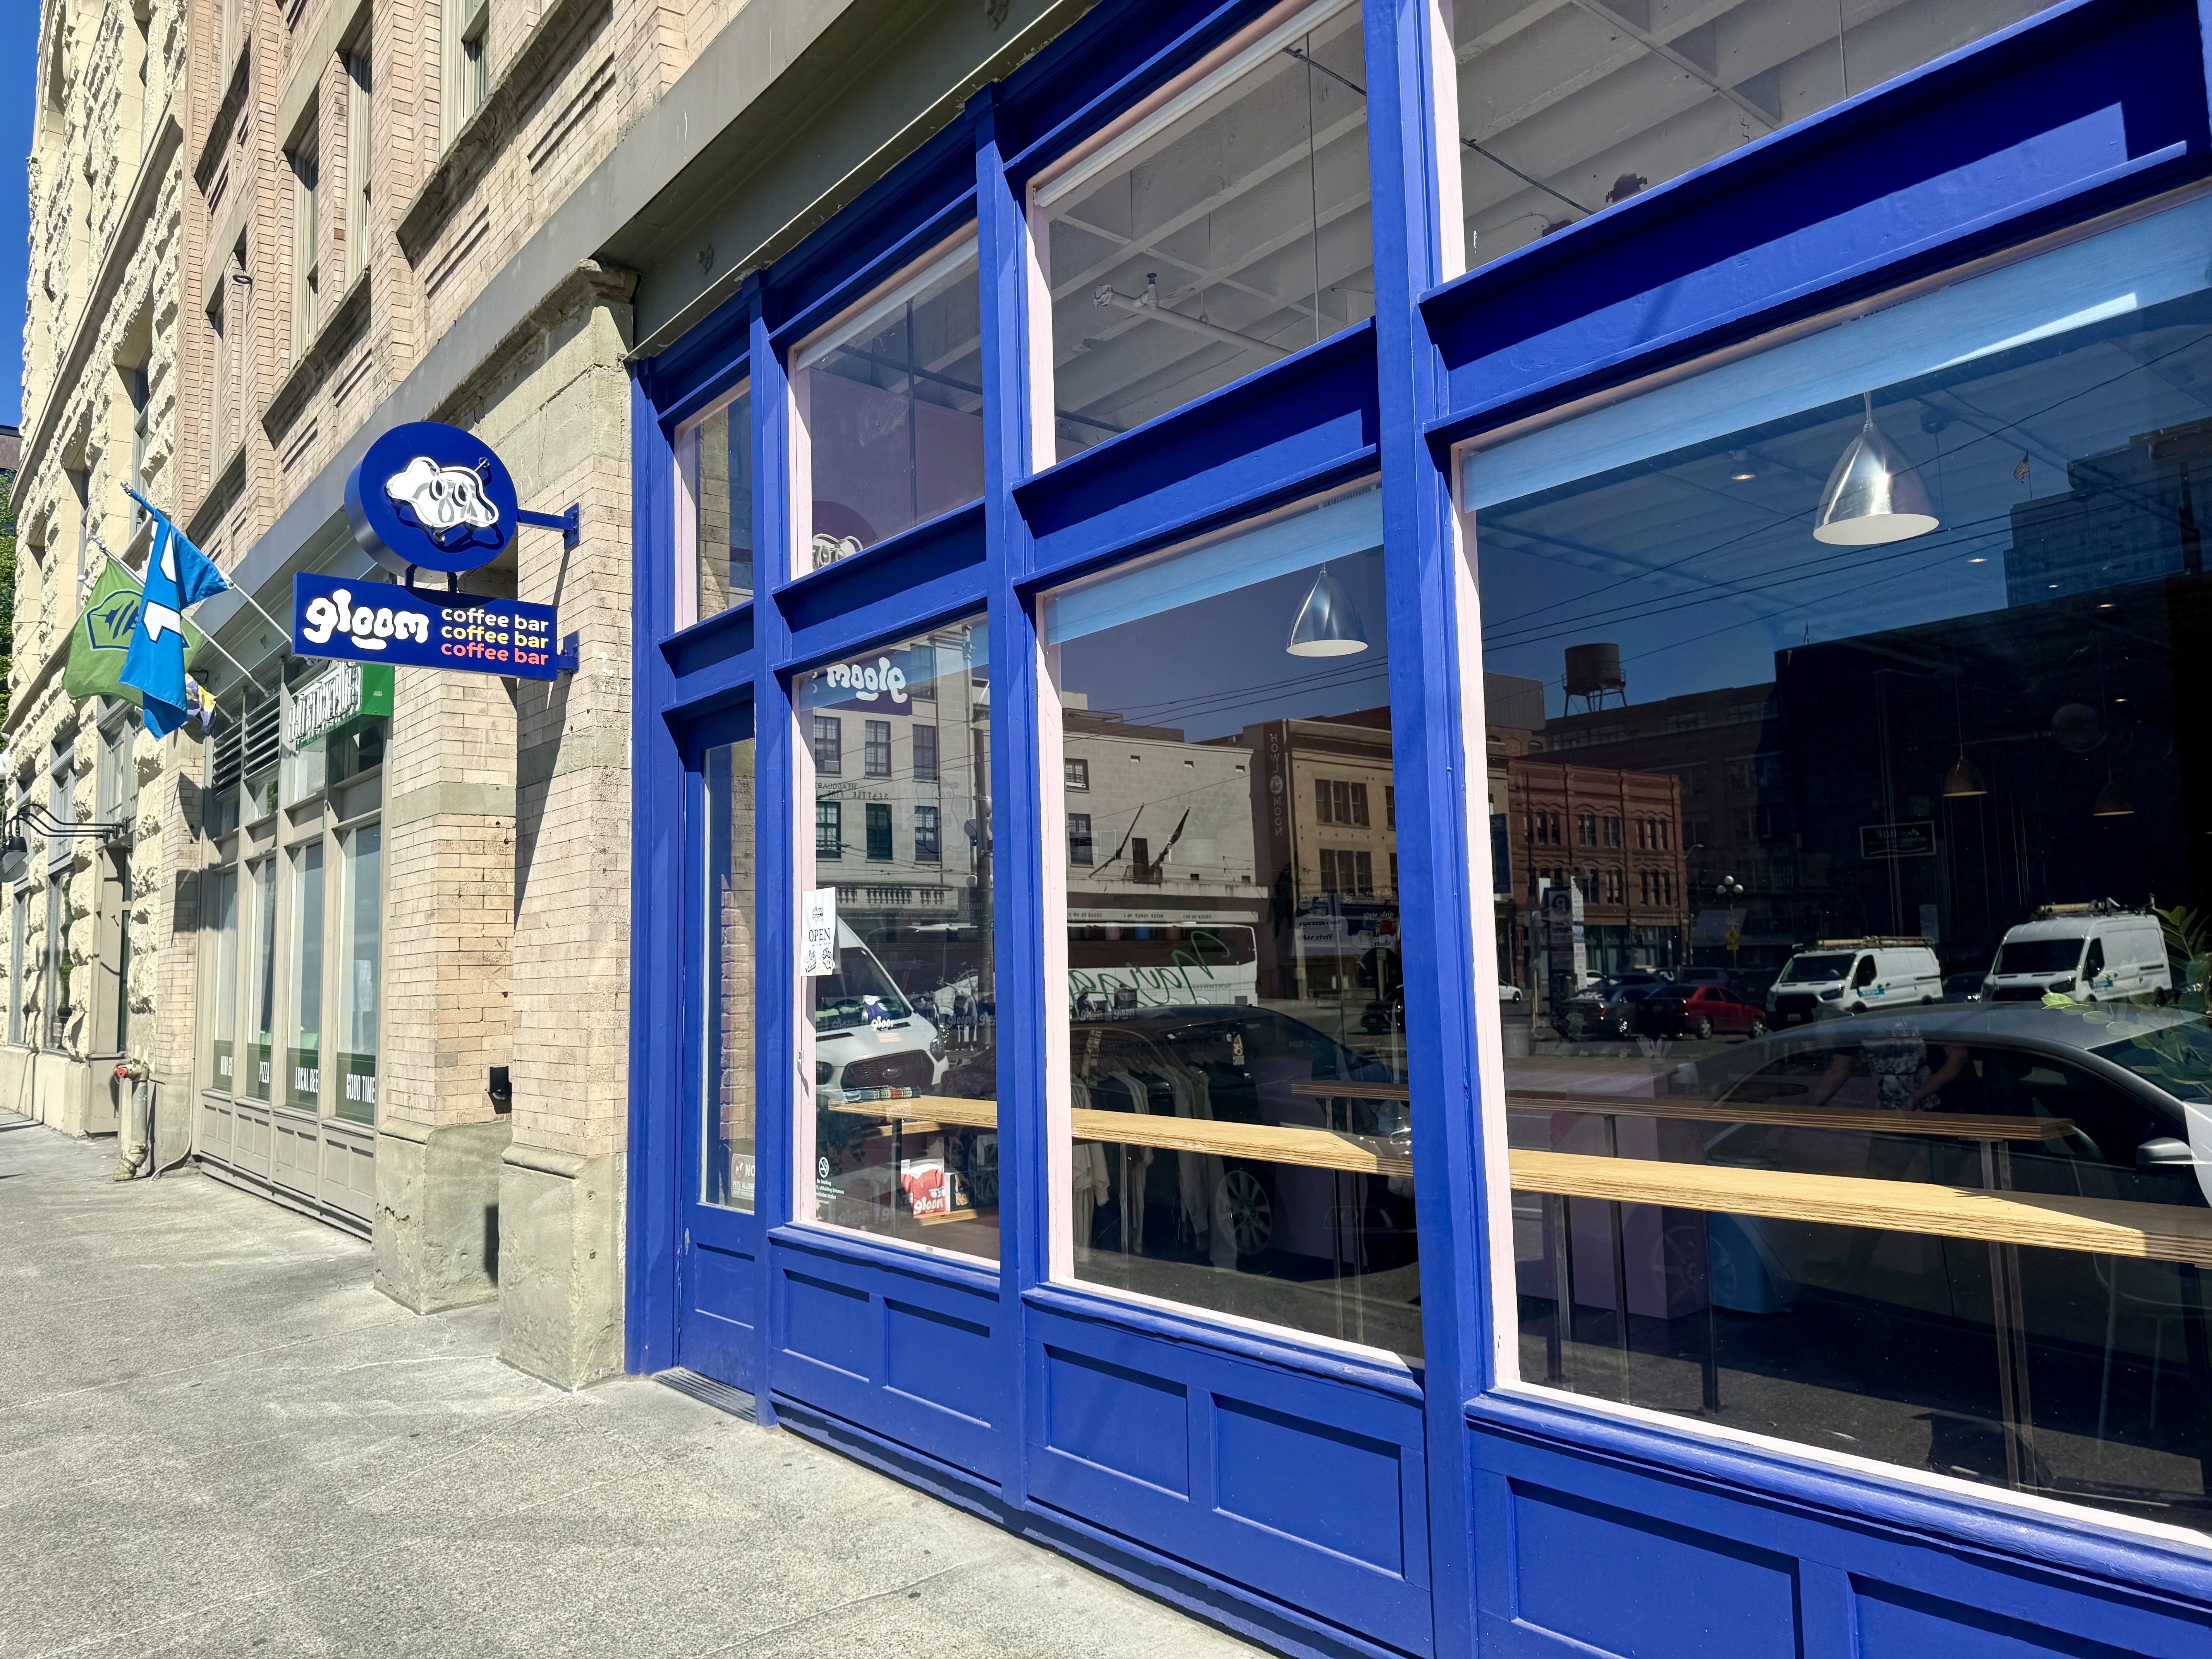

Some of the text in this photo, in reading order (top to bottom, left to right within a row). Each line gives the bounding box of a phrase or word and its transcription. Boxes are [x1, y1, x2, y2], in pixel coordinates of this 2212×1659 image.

[303, 589, 429, 650] gloom
[441, 608, 549, 632] coffee bar
[441, 625, 549, 649] coffee bar
[441, 642, 549, 665] coffee bar
[809, 928, 831, 942] OPEN
[259, 1061, 270, 1084] PIZZA
[295, 1066, 309, 1091] LOCAL
[346, 1073, 375, 1104] GOOD TIME
[745, 1164, 755, 1178] NO
